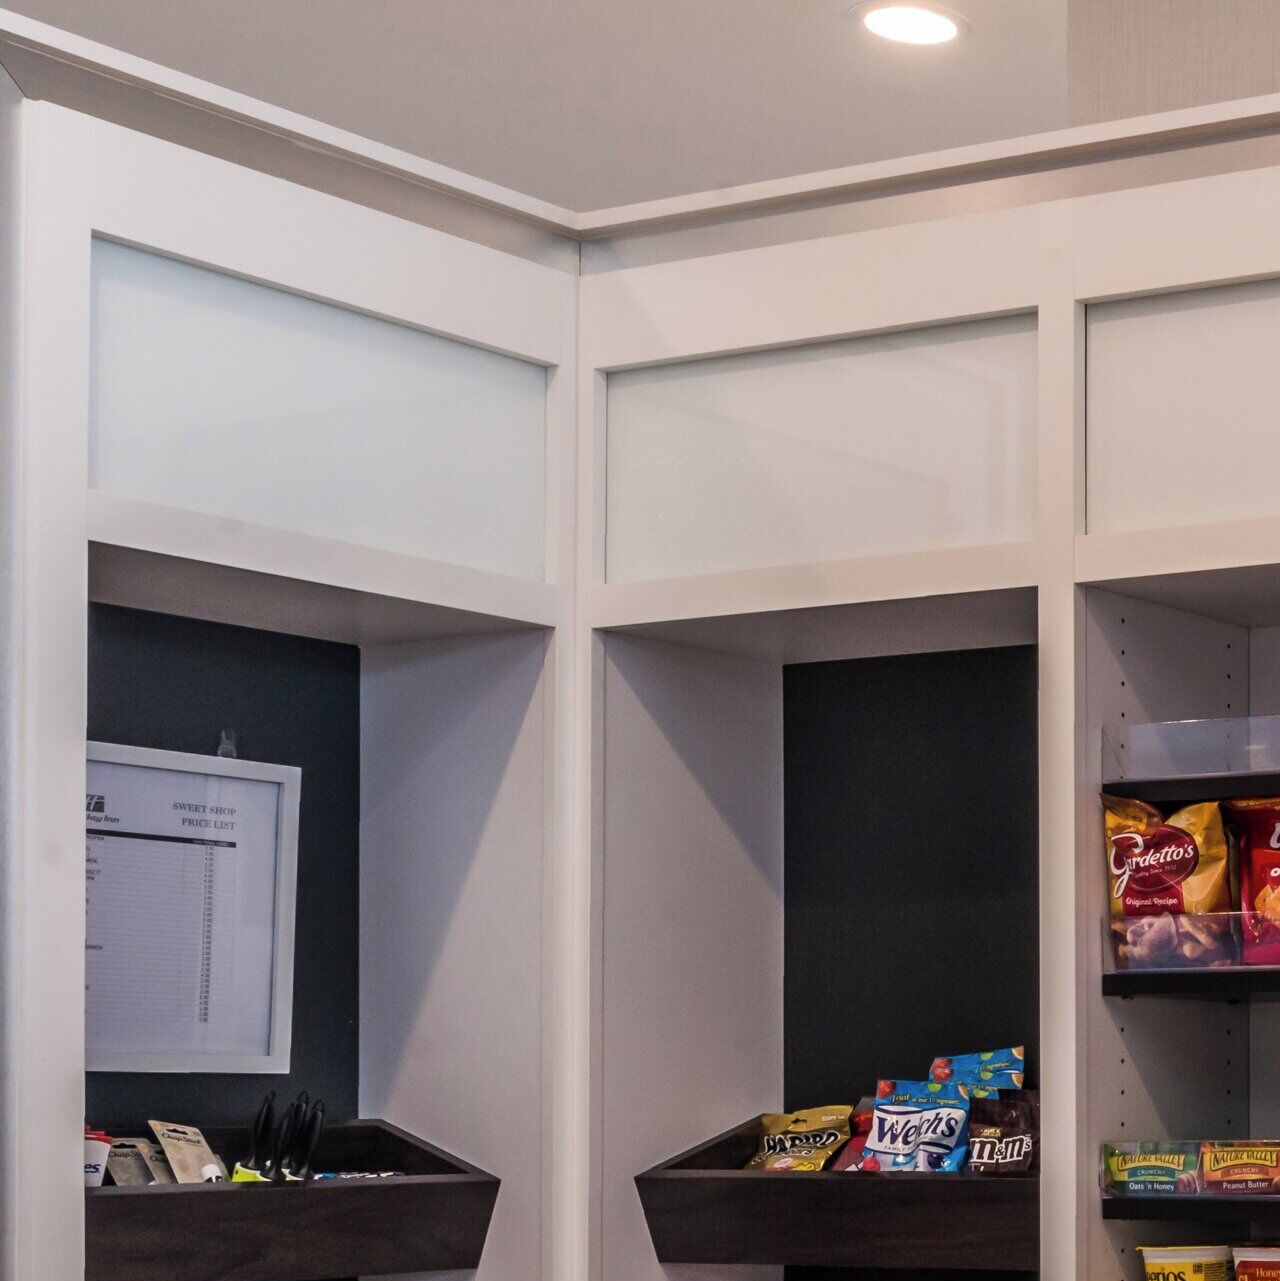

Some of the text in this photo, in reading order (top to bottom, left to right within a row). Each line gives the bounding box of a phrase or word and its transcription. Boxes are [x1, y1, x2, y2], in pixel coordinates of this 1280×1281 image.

[173, 802, 237, 815] SWEET SHOP
[182, 818, 236, 830] PRICE LIST
[1110, 833, 1194, 898] Gardetto's
[1126, 897, 1178, 907] Original Recipe
[876, 1112, 958, 1146] Welch's
[1153, 1154, 1184, 1170] VALLEY
[1246, 1151, 1276, 1167] VALLEY
[1129, 1182, 1144, 1190] Oats
[1153, 1183, 1174, 1191] Honey
